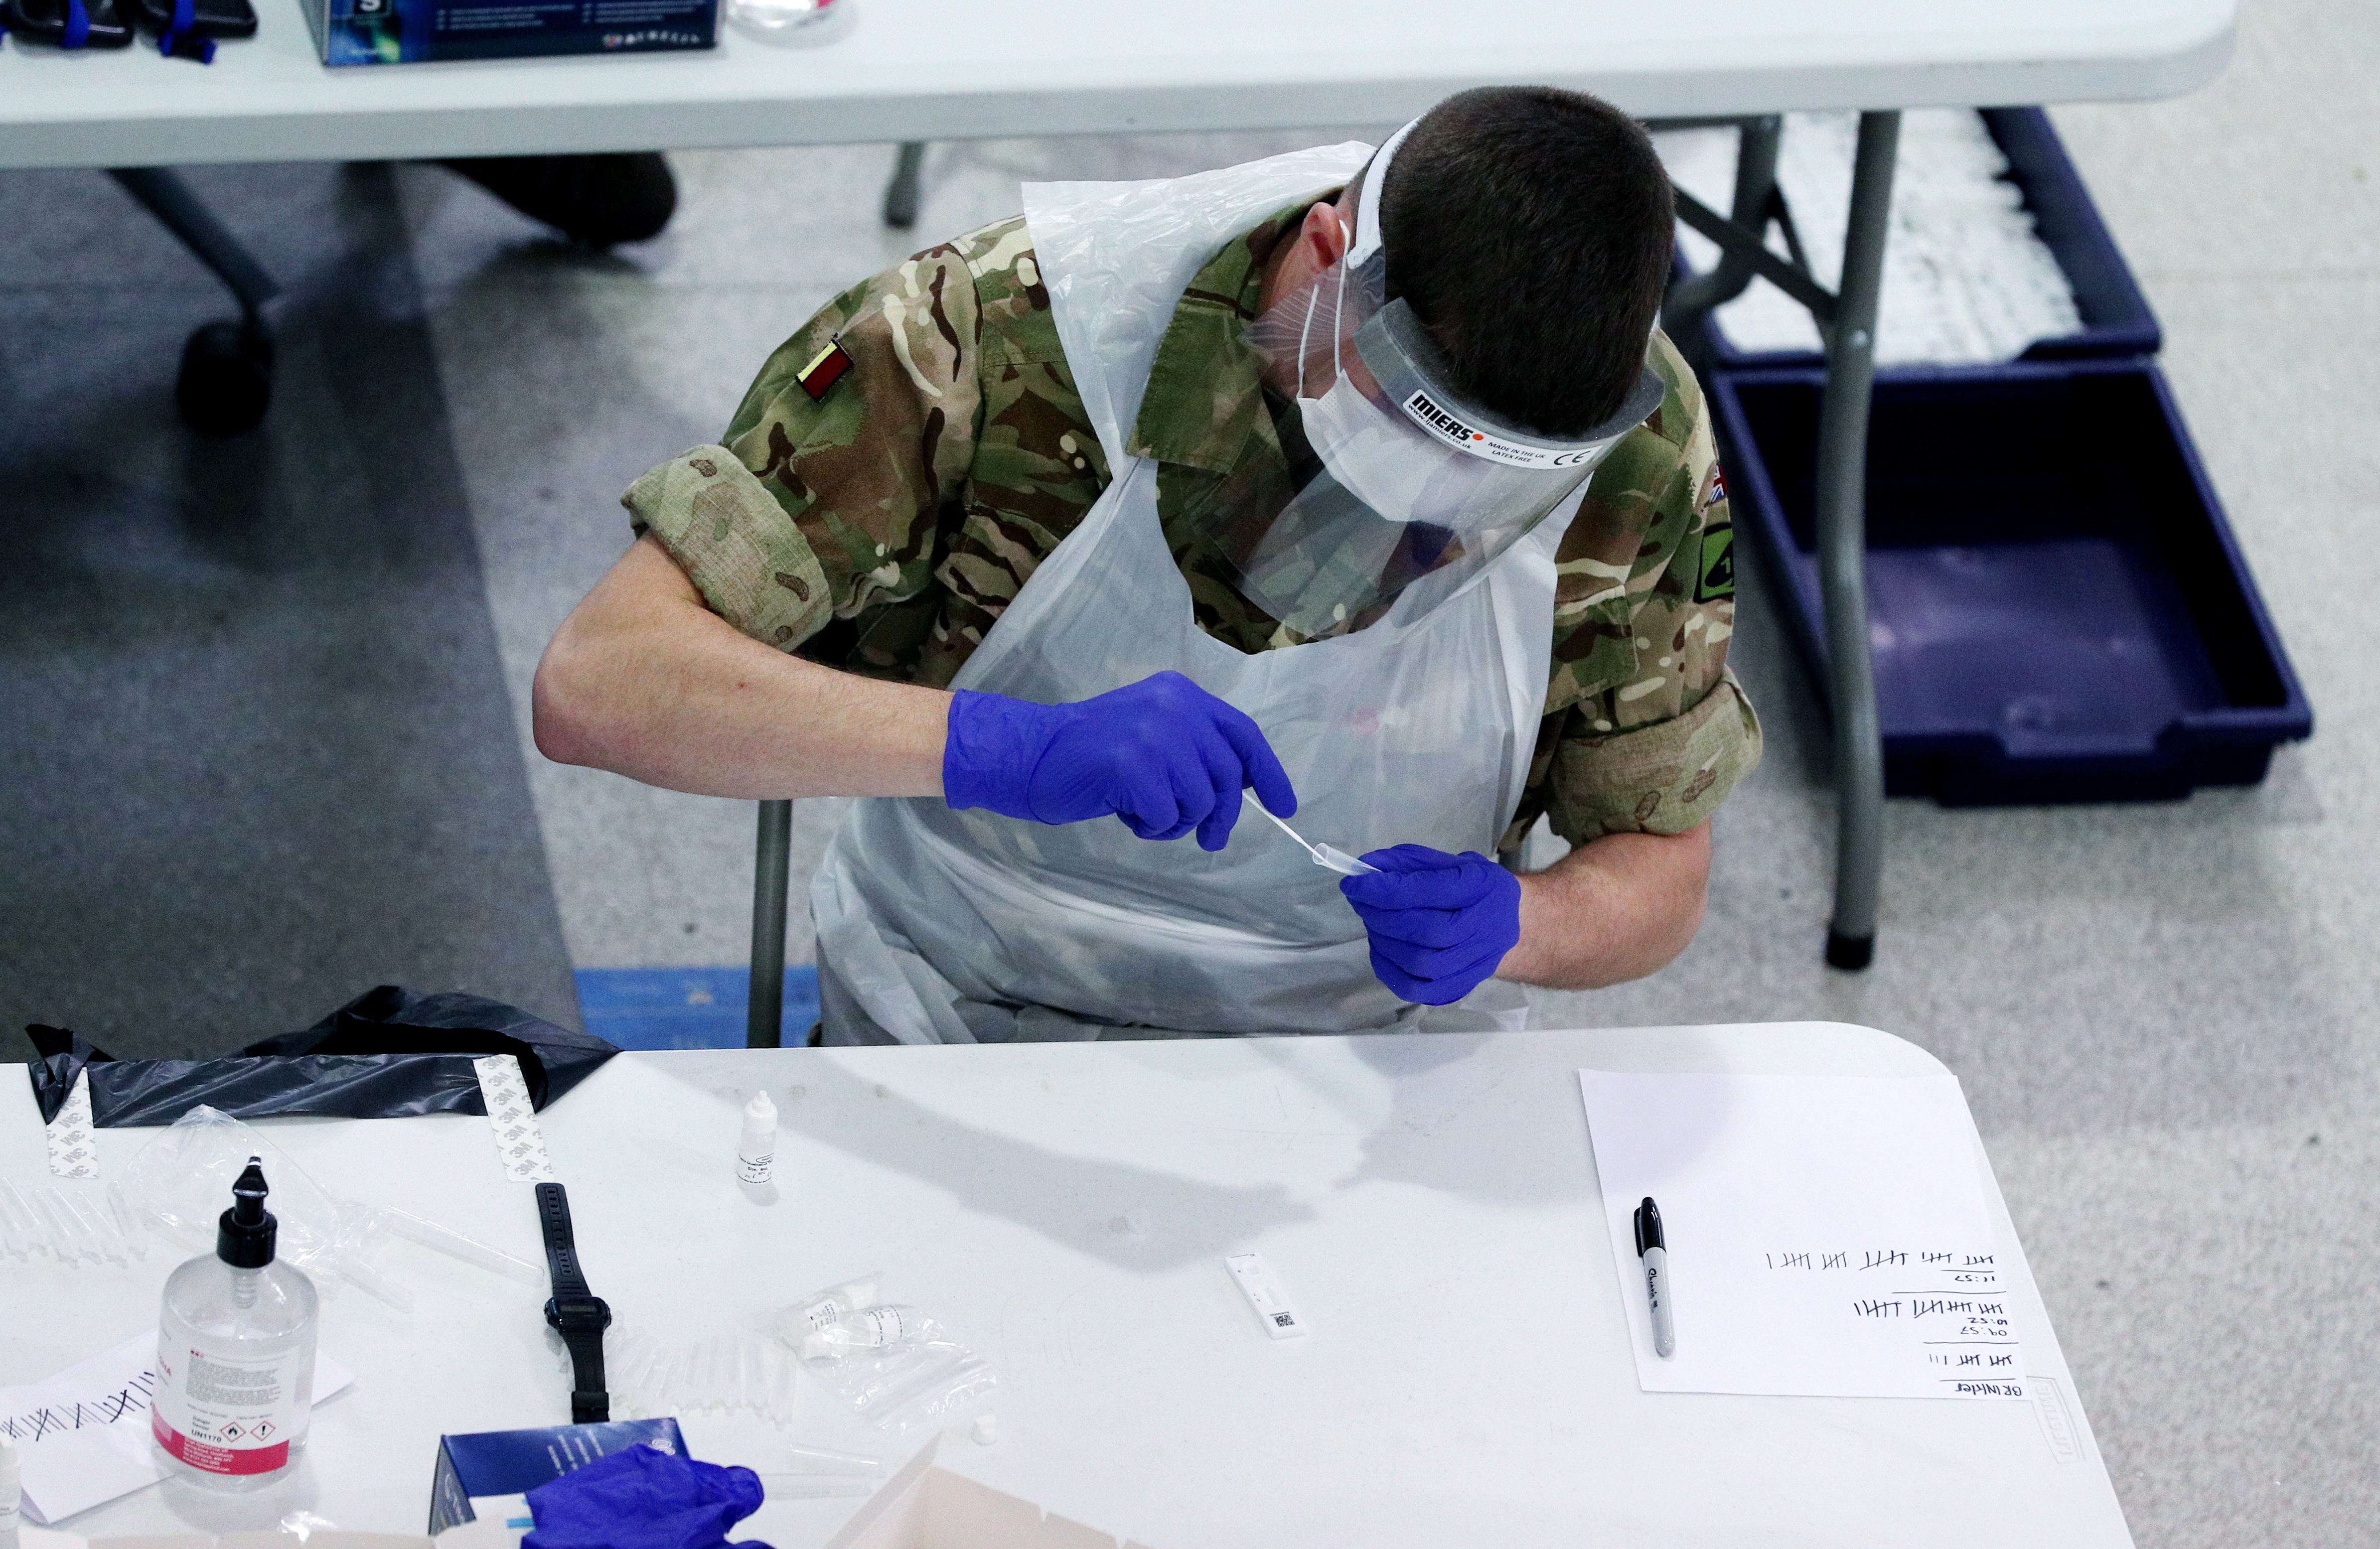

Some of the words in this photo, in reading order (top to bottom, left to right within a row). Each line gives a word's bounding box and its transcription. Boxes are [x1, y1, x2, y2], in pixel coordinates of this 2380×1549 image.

[1412, 394, 1474, 441] MIERS
[1408, 404, 1472, 448] www.ljamiers.co.uk
[1488, 442, 1511, 451] MADE
[1492, 450, 1515, 459] LATEX
[487, 1072, 511, 1087] 3M
[493, 1088, 517, 1106] 3M
[58, 1113, 84, 1128] 3M
[498, 1107, 522, 1124] 3M
[60, 1130, 86, 1146] 3M
[504, 1125, 528, 1141] 3M
[62, 1148, 88, 1163] 3M
[509, 1142, 533, 1158] 3M
[514, 1159, 539, 1175] 3M
[1960, 1326, 2007, 1336] 09:57
[191, 1429, 222, 1443] UN1170
